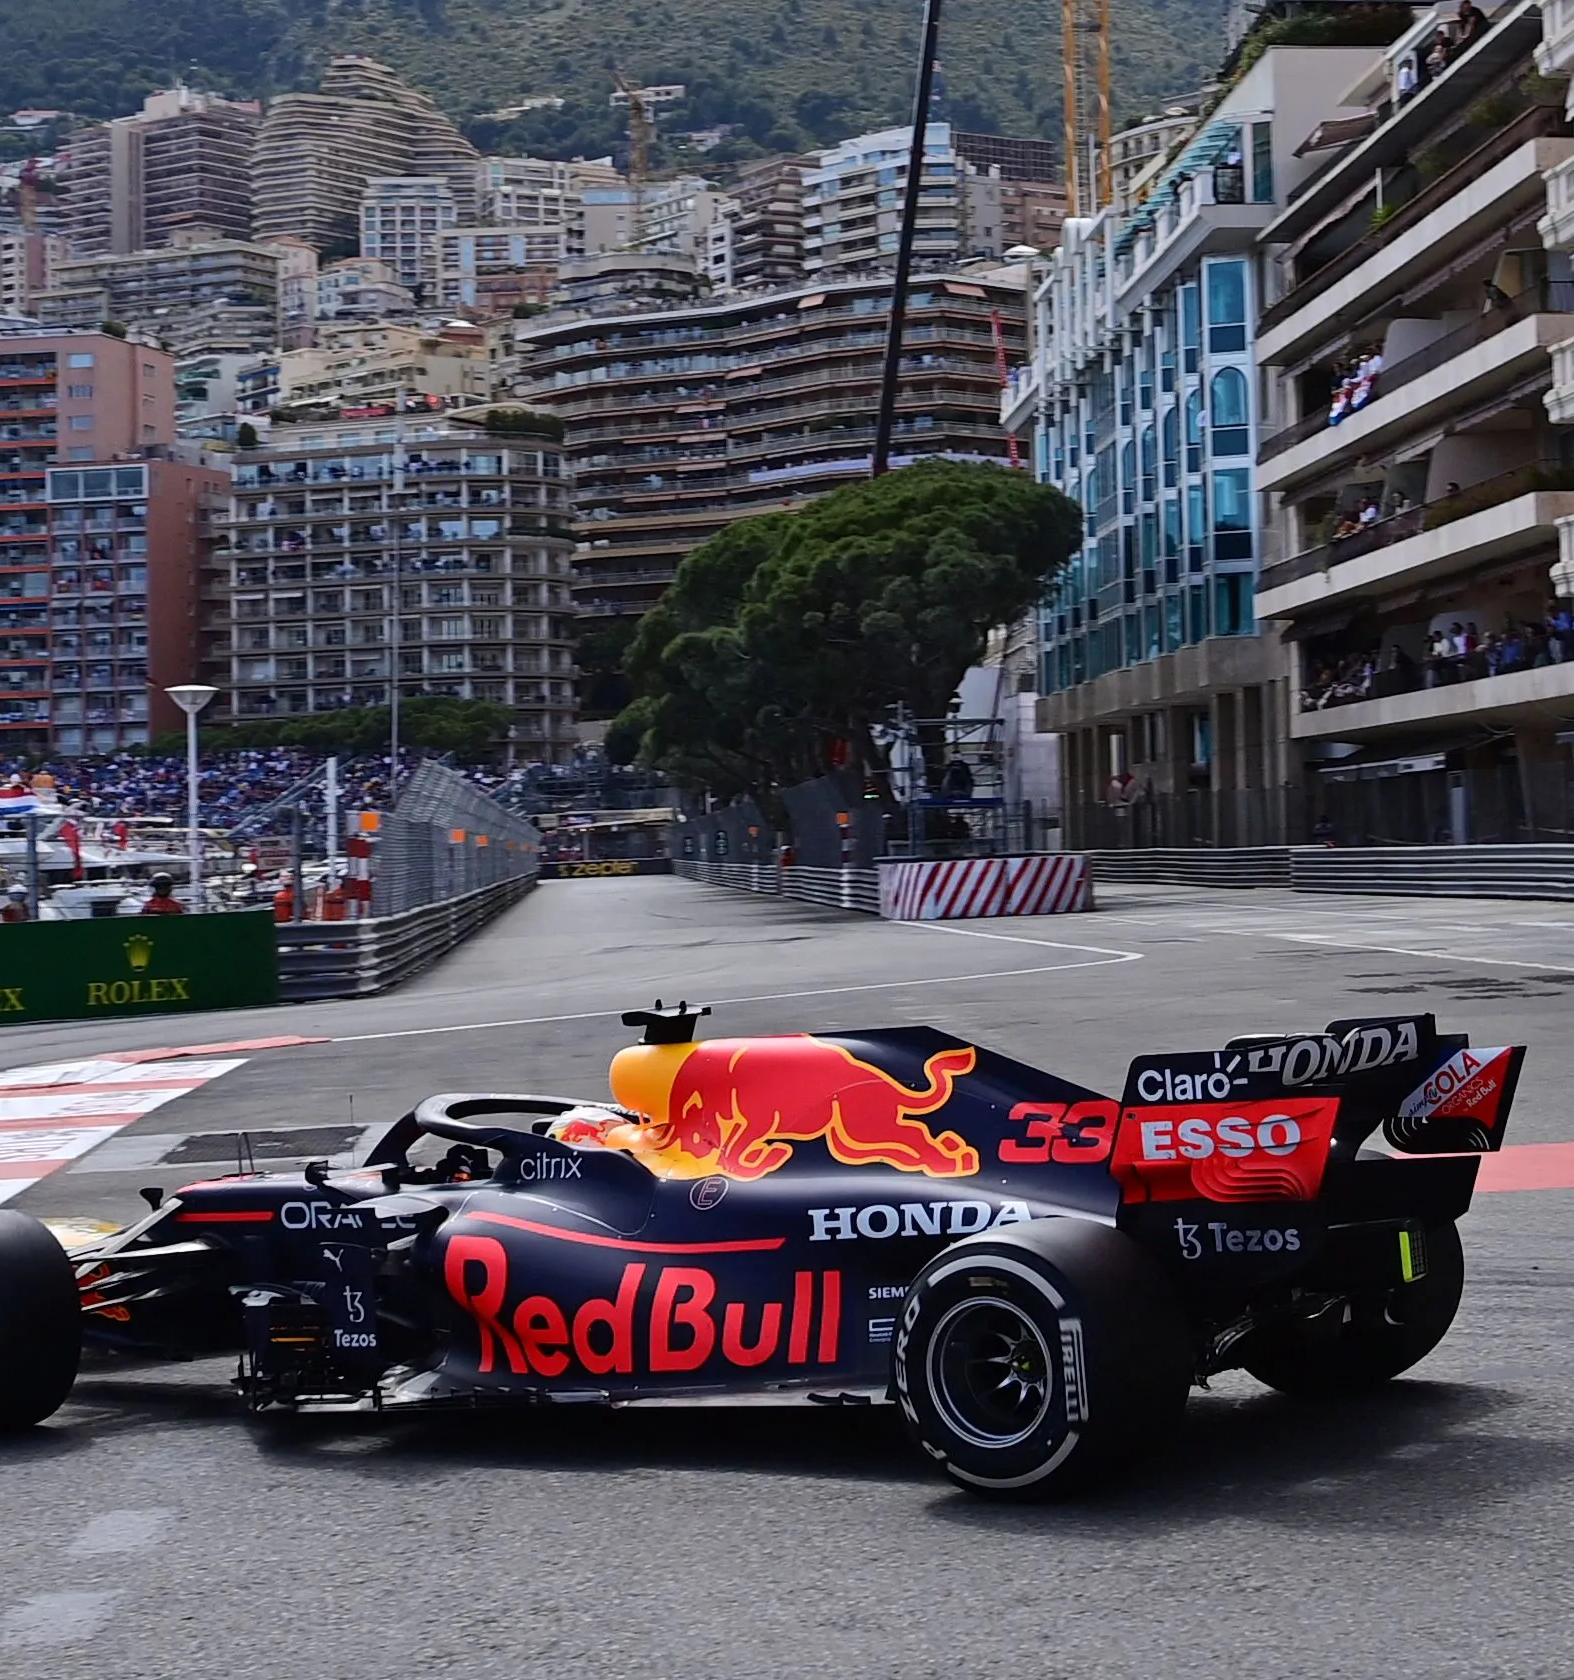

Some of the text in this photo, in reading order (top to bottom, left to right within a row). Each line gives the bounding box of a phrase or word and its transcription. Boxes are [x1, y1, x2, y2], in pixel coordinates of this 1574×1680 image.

[87, 977, 190, 1006] ROLEX
[1137, 1067, 1230, 1101] Claro
[1423, 1051, 1481, 1105] COLA
[998, 1100, 1121, 1164] 33
[1139, 1114, 1301, 1161] ESSO
[520, 1151, 584, 1181] citrix
[1207, 1222, 1301, 1253] Tezos
[444, 1235, 841, 1377] Red Bull
[333, 1328, 377, 1347] Tezos
